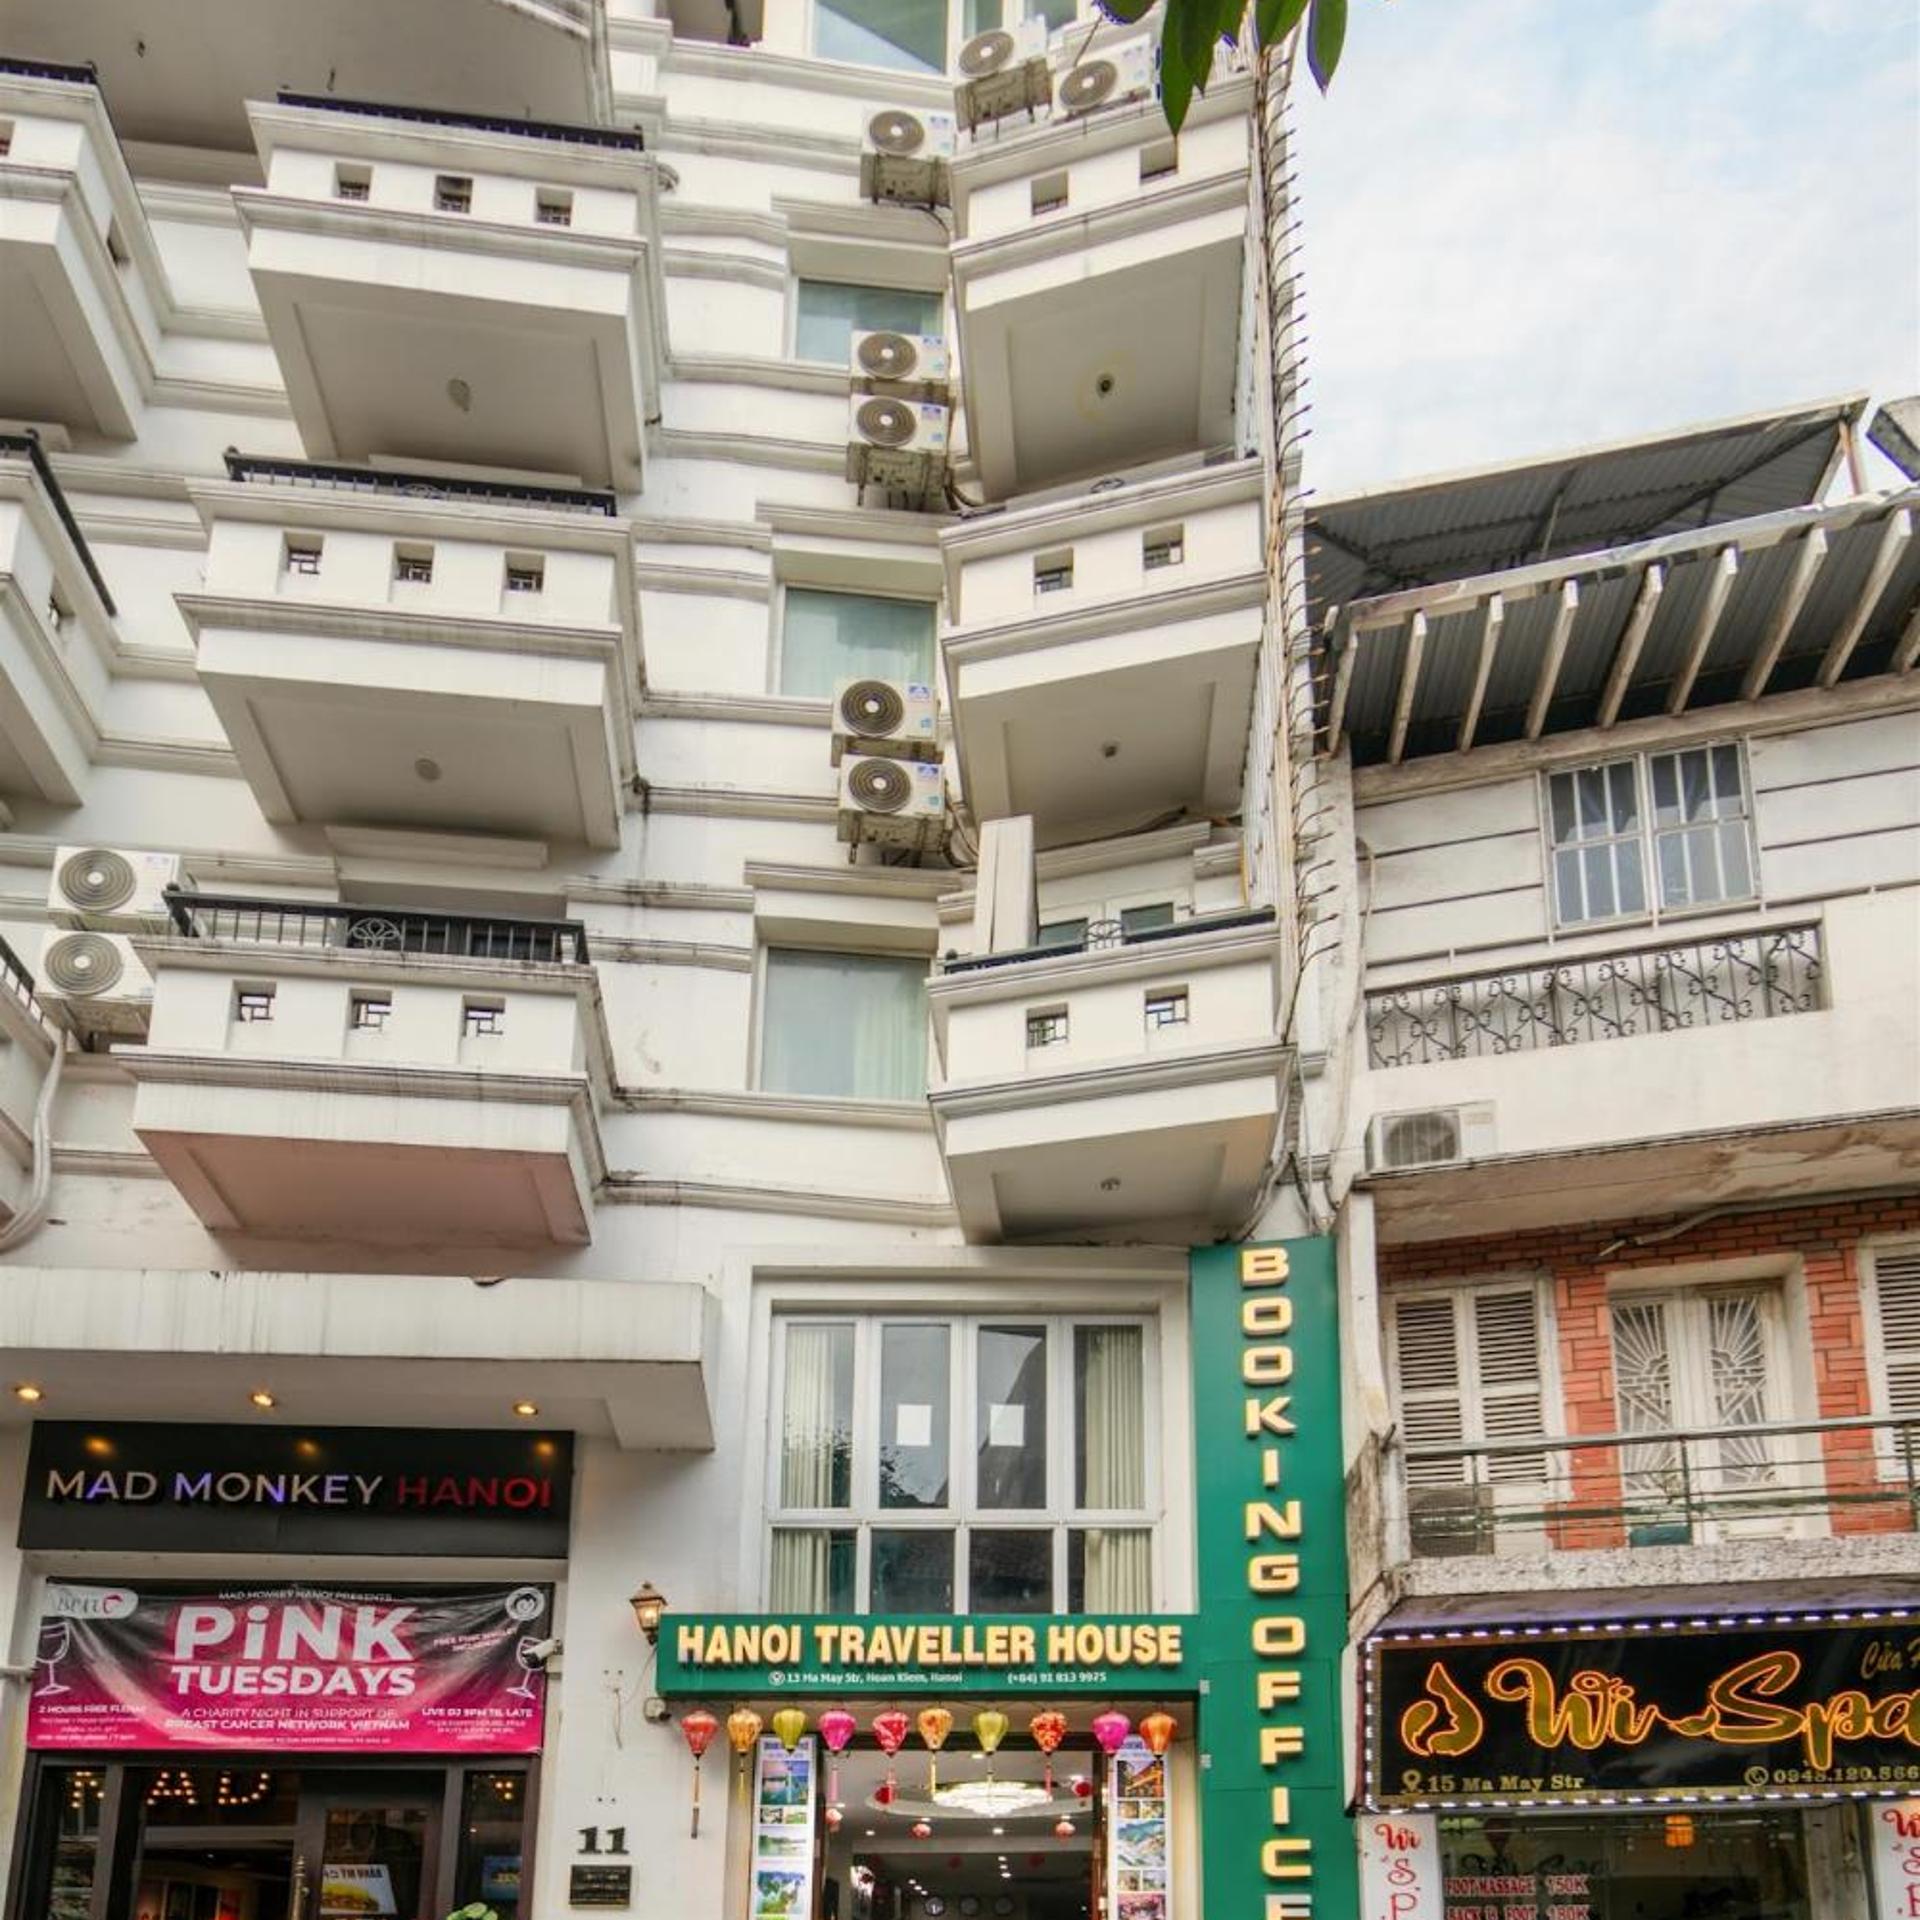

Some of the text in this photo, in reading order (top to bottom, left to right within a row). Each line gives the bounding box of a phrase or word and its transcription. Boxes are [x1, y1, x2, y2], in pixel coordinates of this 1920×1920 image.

[1240, 1247, 1301, 1592] BOOKING
[46, 1470, 551, 1508] MAD MONKEY HANOI
[218, 1592, 245, 1601] MAD
[247, 1590, 294, 1601] MONKEY
[297, 1590, 333, 1600] HANOI
[677, 1623, 1184, 1665] HANOI TRAVELLER HOUSE
[171, 1664, 416, 1697] TUESDAYS
[821, 1674, 842, 1684] May
[182, 1708, 398, 1719] A CHARITY NIGHT IN SUPPORT OF
[422, 1708, 445, 1717] LIVE
[506, 1708, 533, 1718] LATE
[1486, 1650, 1920, 1770] Wi Spa
[166, 1718, 410, 1731] BREAST CANCER NETWORK VIETNAM
[1252, 1616, 1313, 1920] OFFICE
[1427, 1774, 1584, 1793] 15 Ma May Str
[577, 1826, 630, 1855] 11
[1375, 1823, 1421, 1851] Wi
